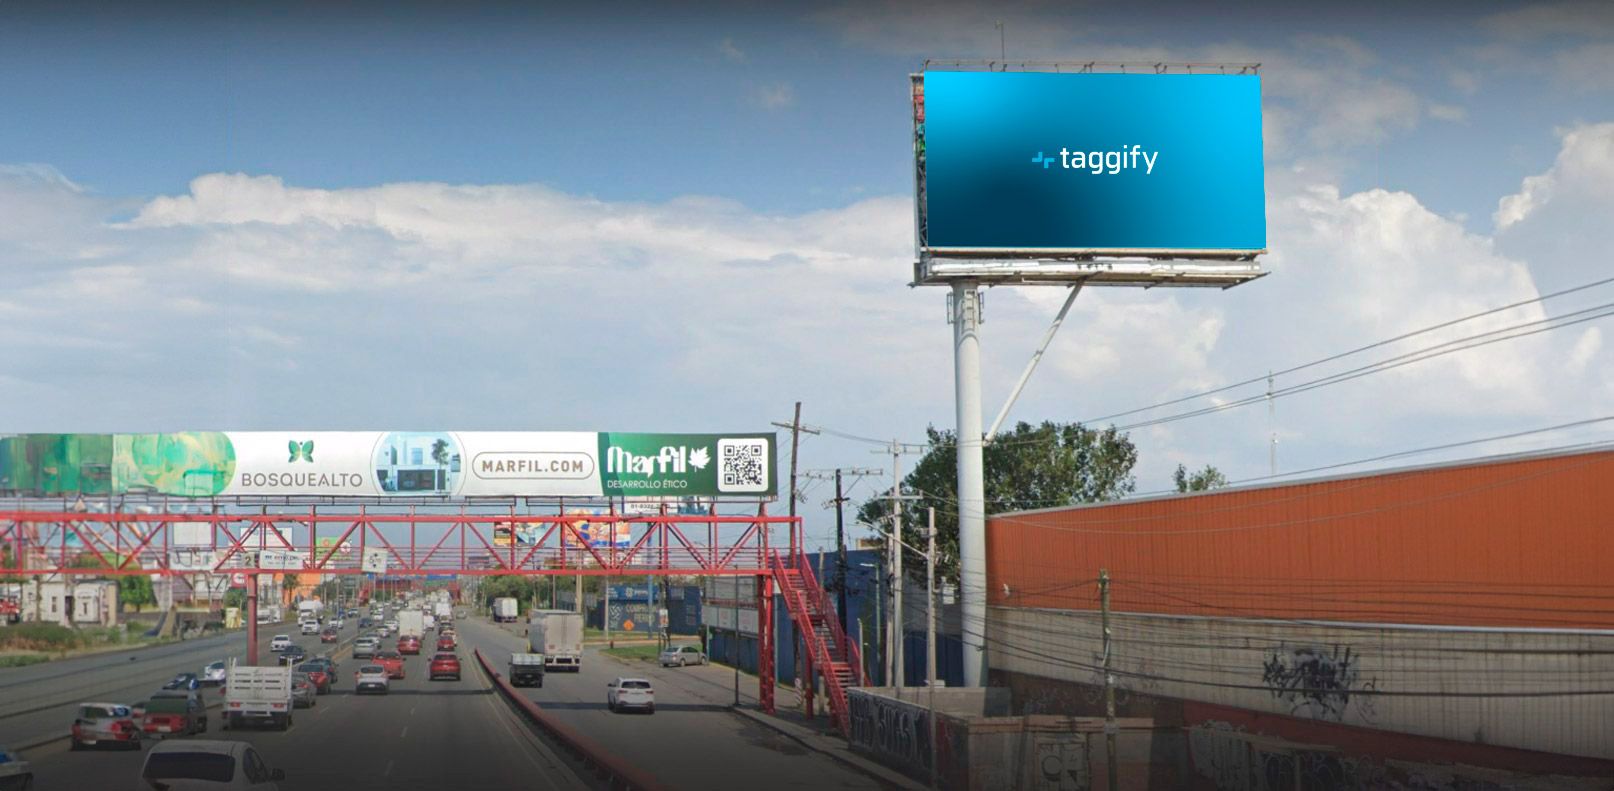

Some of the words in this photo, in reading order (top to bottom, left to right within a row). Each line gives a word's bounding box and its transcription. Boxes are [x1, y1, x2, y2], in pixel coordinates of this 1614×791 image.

[1060, 145, 1159, 174] taggify
[482, 460, 584, 473] MARFIL.COM
[608, 446, 686, 478] Marfil
[242, 473, 363, 487] BOSQUEALTO
[607, 480, 661, 489] DESARROLLO
[662, 479, 687, 489] ÉTICO
